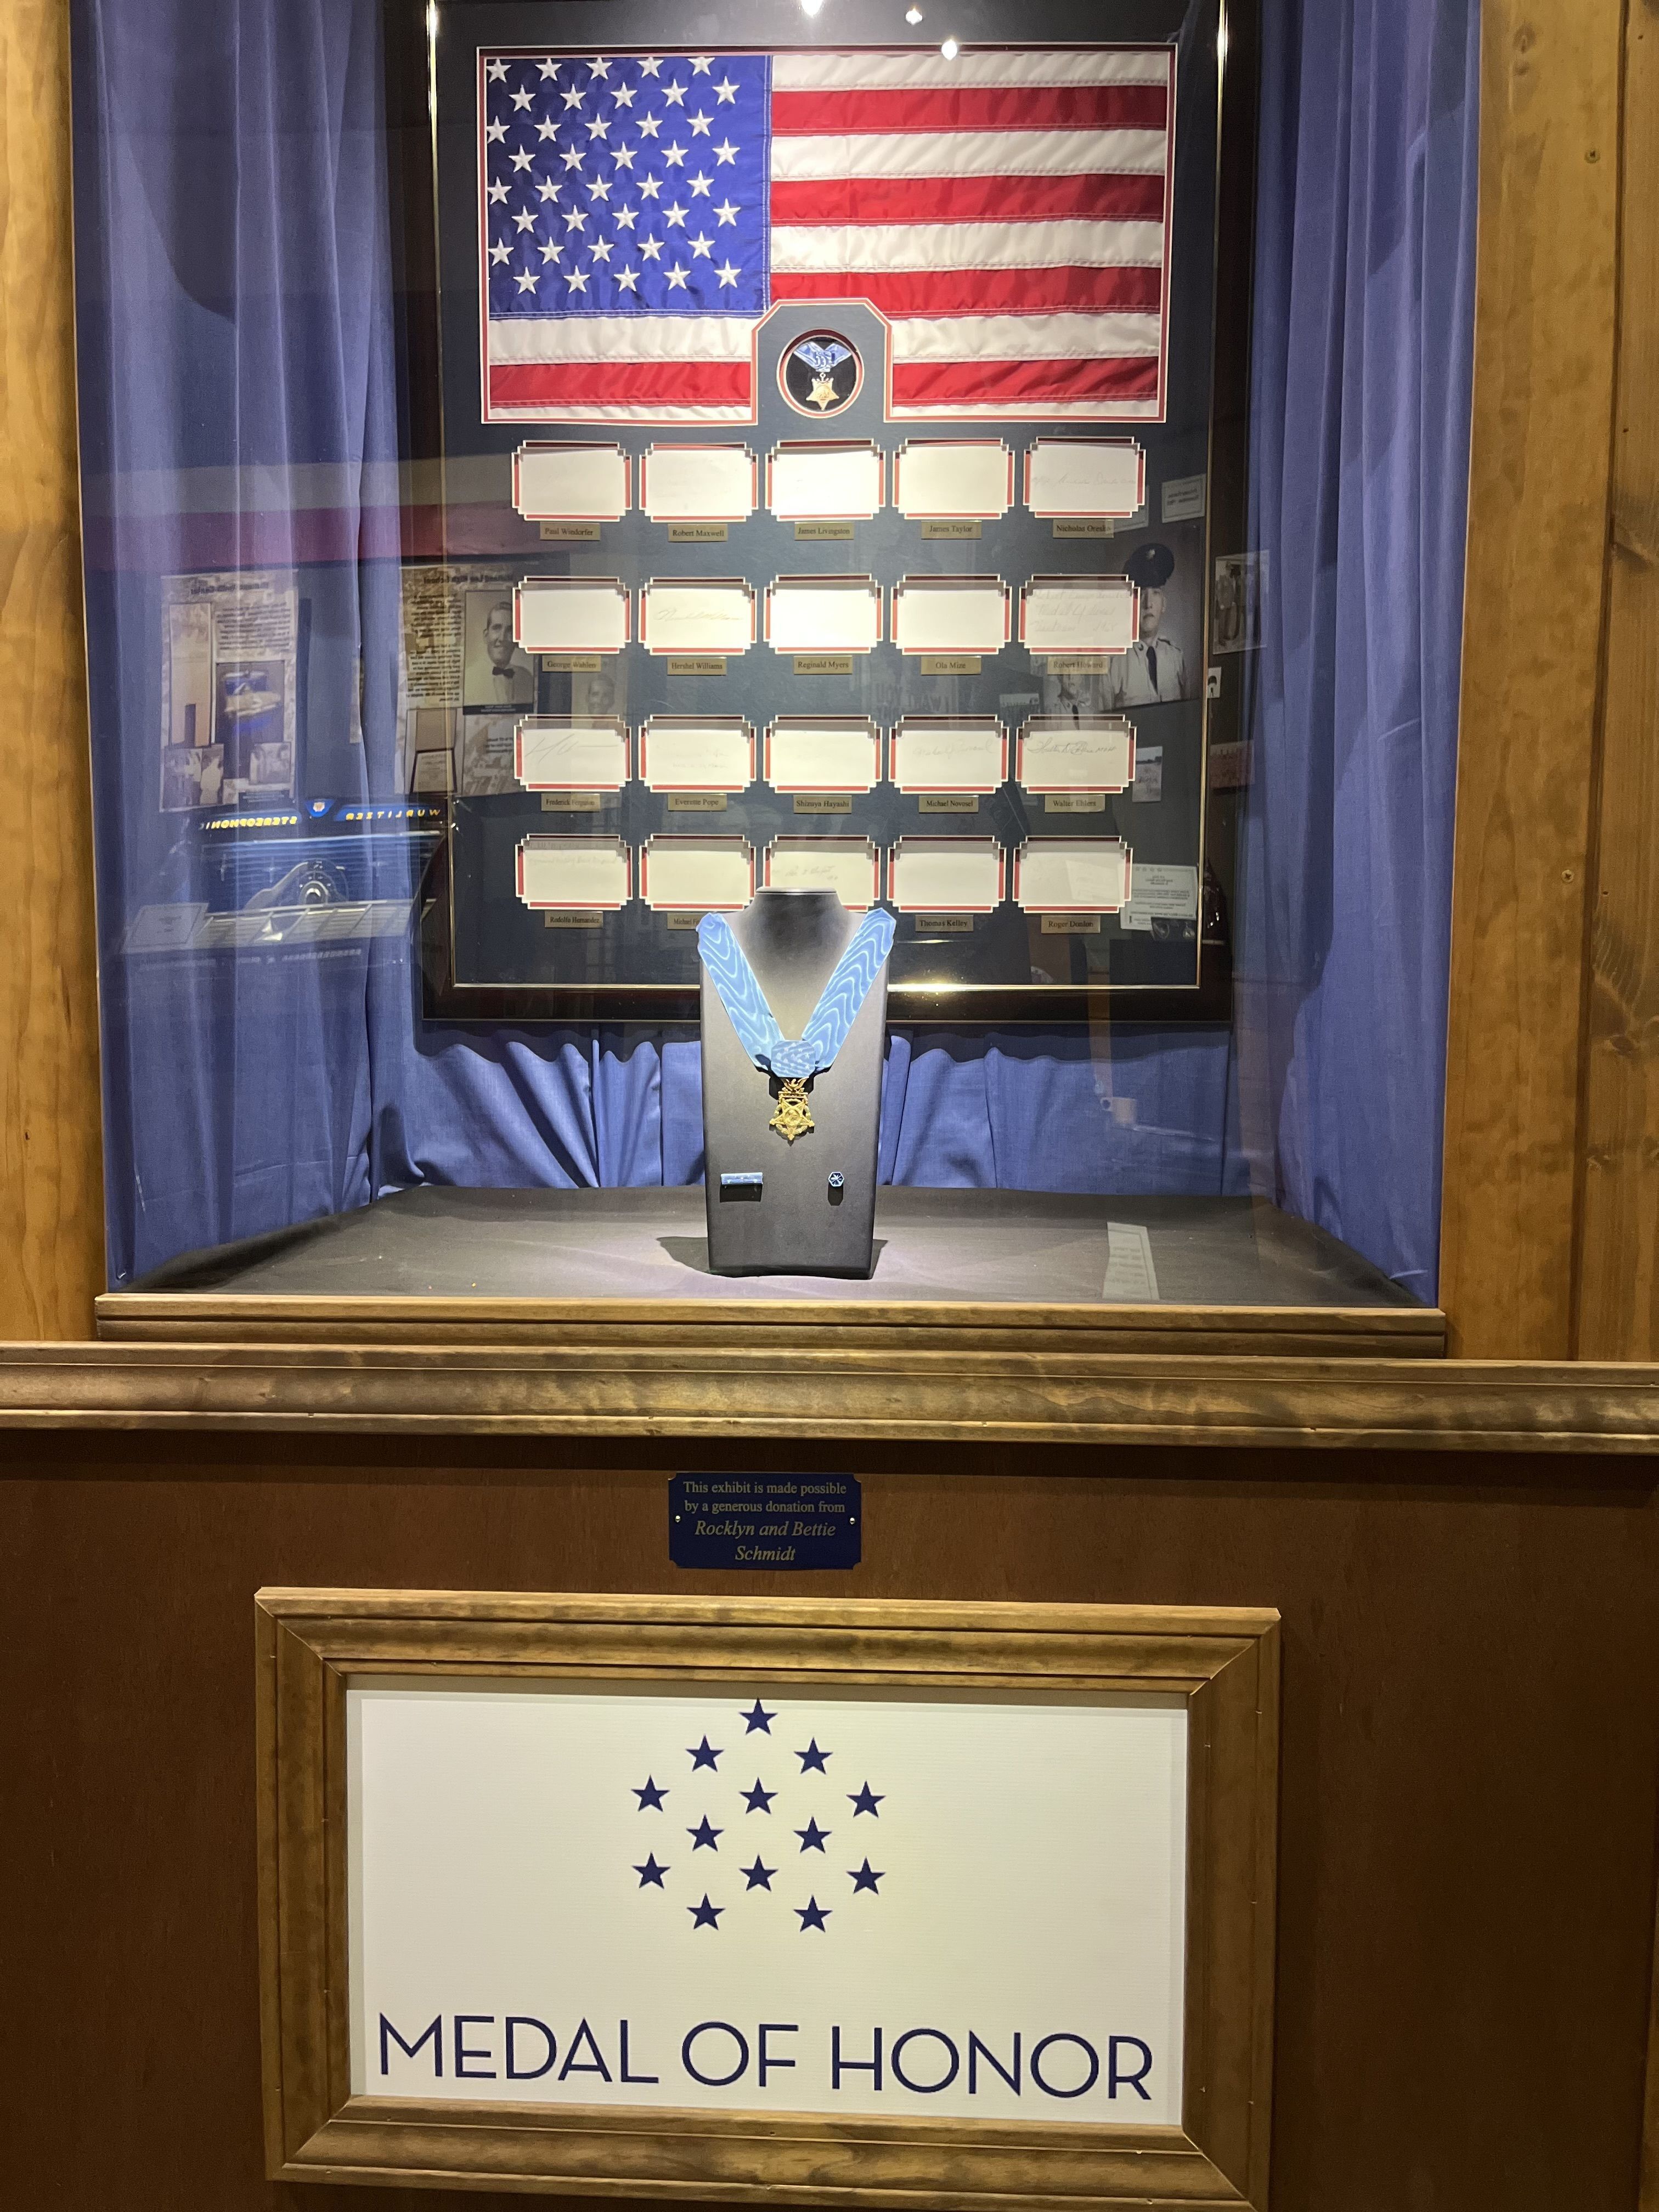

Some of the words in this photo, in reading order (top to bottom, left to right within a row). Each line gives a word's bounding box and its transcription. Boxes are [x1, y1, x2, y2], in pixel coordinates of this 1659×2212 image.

[561, 527, 593, 536] Wiedorfer
[818, 527, 850, 536] Livingston
[952, 525, 973, 534] Taylor
[548, 661, 571, 669] George
[798, 661, 827, 670] Reginald
[828, 661, 849, 670] Myers
[1077, 661, 1103, 669] Howard
[703, 798, 719, 807] Pope
[796, 800, 822, 809] Shizuya
[823, 800, 849, 809] Hayashi
[947, 919, 968, 928] Kelley
[683, 1481, 708, 1493] This
[712, 1481, 751, 1493] exhibit
[754, 1481, 763, 1493] is
[766, 1482, 797, 1494] made
[800, 1482, 847, 1497] possible
[685, 1500, 698, 1514] by
[712, 1503, 762, 1514] generous
[766, 1500, 815, 1513] donation
[818, 1501, 845, 1513] from
[695, 1520, 755, 1539] Rocklyn
[759, 1521, 787, 1536] and
[792, 1521, 836, 1537] Bettie
[735, 1545, 796, 1561] Schmidt
[380, 2013, 658, 2083] MEDAL
[682, 2022, 798, 2087] OF
[832, 2026, 1152, 2100] HONOR
